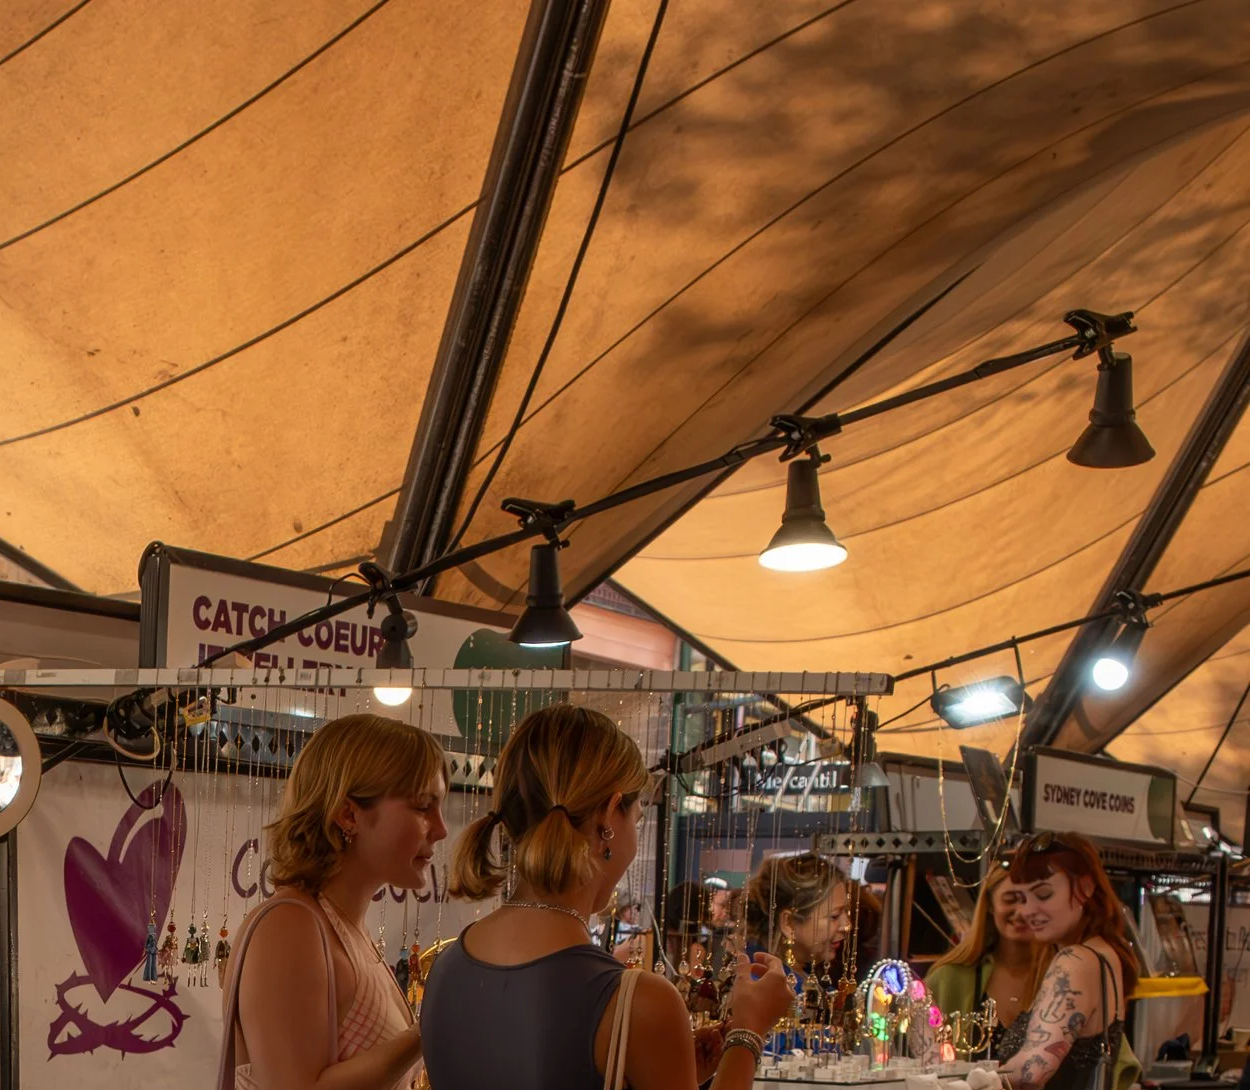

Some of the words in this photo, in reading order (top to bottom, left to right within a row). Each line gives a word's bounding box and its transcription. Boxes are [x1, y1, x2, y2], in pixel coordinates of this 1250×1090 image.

[192, 595, 287, 643] CATCH
[297, 618, 384, 658] COEUR
[1043, 783, 1082, 807] SYDNEY
[1083, 789, 1108, 811] COVE
[1108, 794, 1136, 815] COINS
